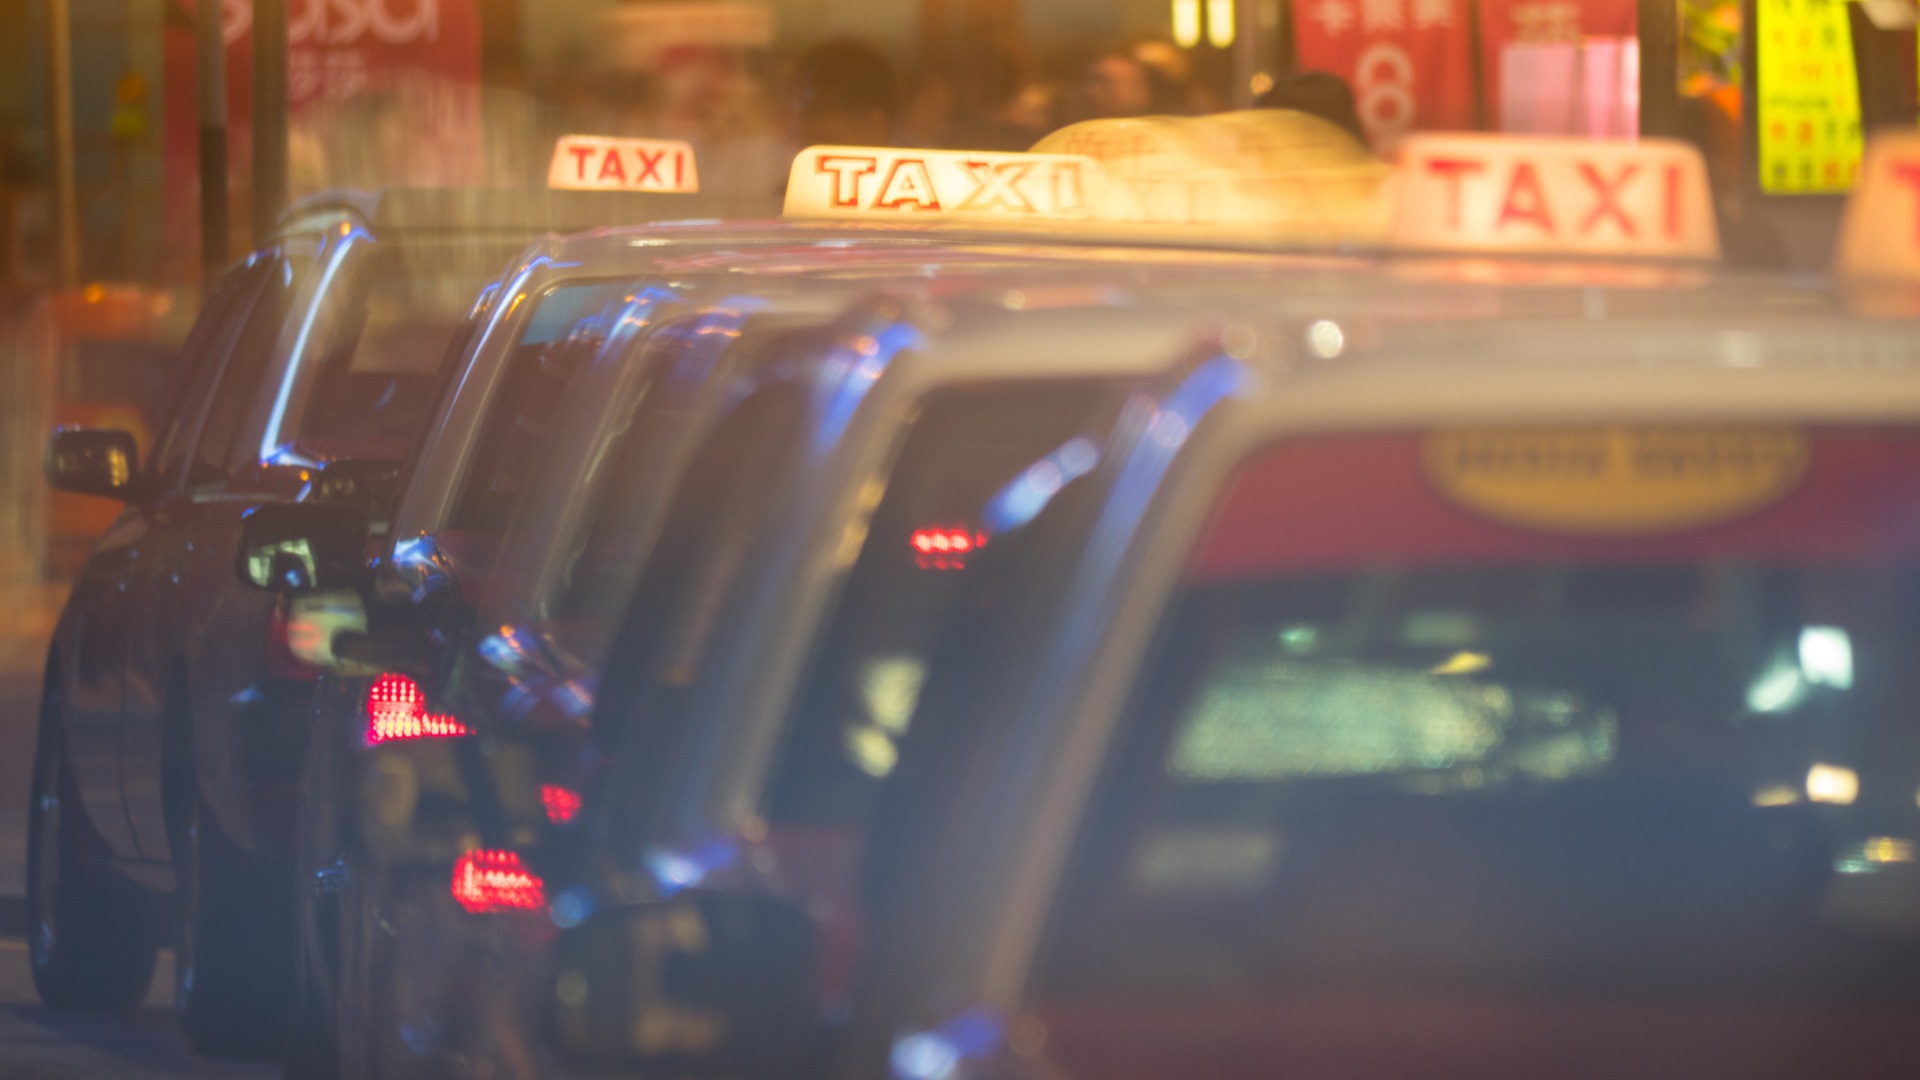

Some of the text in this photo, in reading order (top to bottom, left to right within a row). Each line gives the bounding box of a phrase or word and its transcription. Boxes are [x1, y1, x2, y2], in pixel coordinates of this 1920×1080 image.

[567, 146, 684, 187] TAXI
[814, 155, 1089, 216] TAXI
[1426, 157, 1684, 241] TAXI
